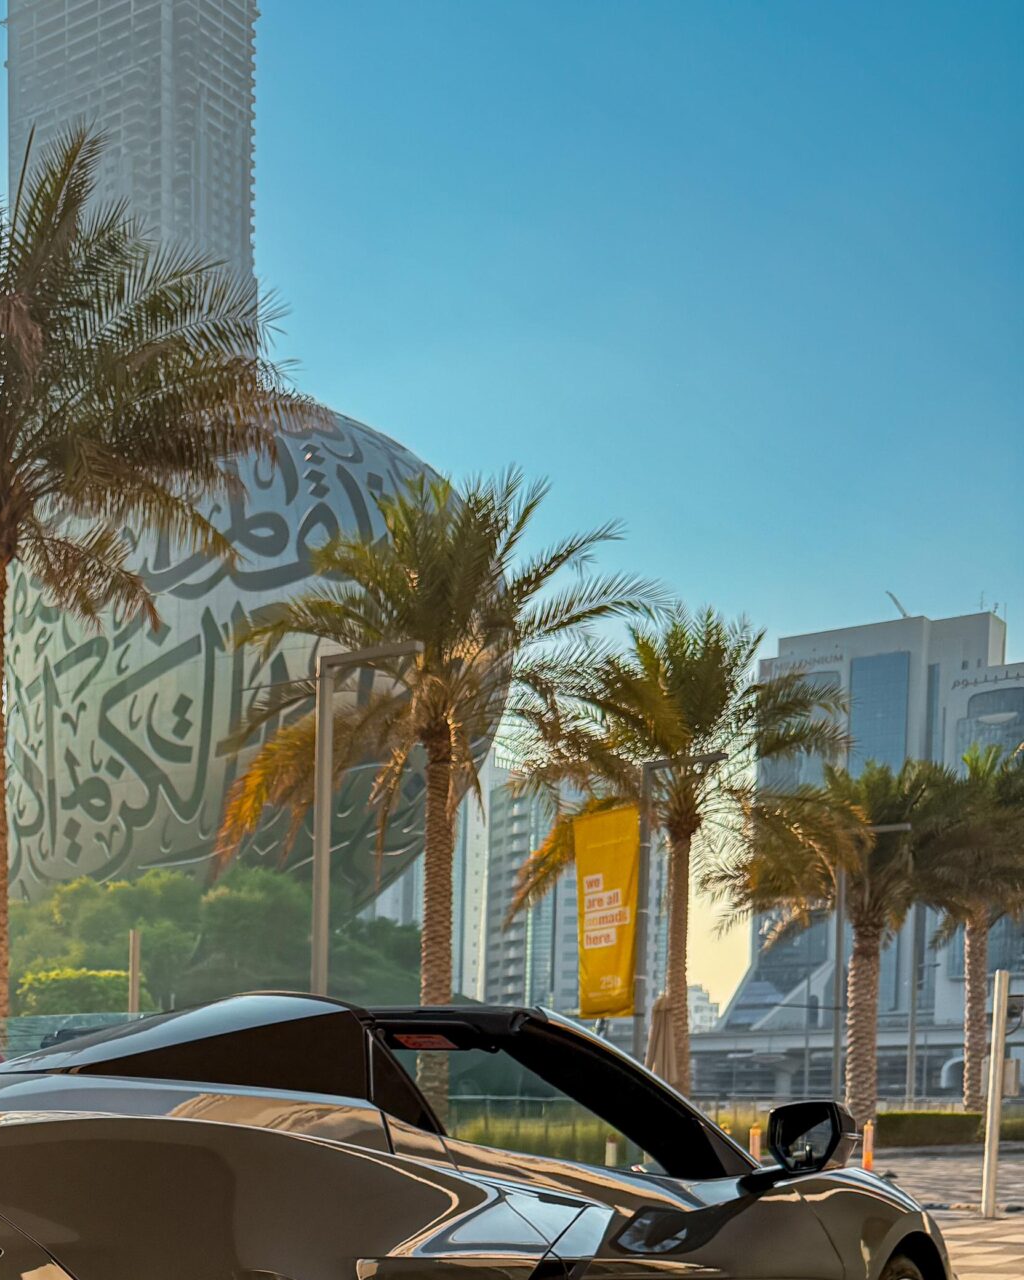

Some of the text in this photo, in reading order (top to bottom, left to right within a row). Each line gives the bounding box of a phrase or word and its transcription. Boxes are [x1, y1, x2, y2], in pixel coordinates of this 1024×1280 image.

[585, 877, 601, 890] we
[587, 890, 619, 910] are all
